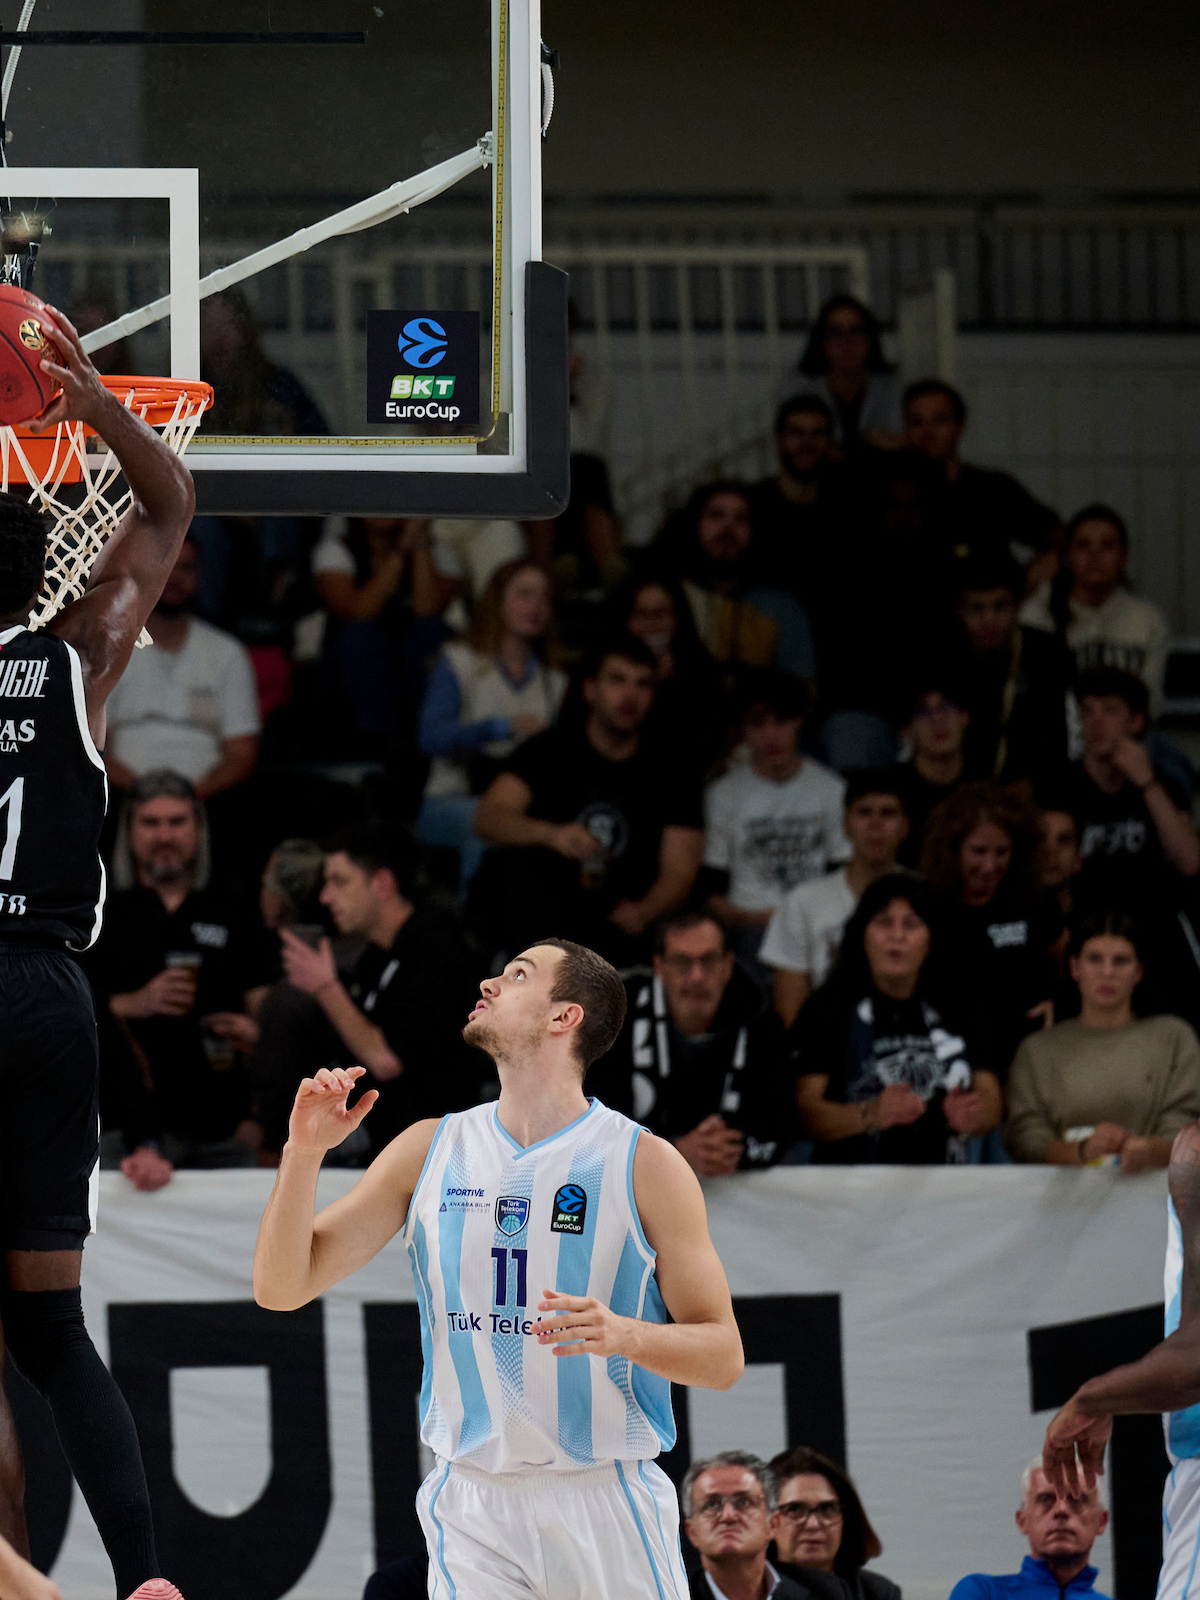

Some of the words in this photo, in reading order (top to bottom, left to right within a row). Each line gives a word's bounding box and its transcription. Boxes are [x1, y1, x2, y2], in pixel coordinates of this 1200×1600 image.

[392, 379, 453, 395] BKT
[385, 402, 461, 422] EuroCup
[446, 1188, 485, 1197] SPORTIVE
[501, 1205, 526, 1213] Telekom
[557, 1214, 579, 1222] BKT
[553, 1222, 582, 1231] EuroCup
[491, 1247, 528, 1308] 11
[489, 1313, 568, 1336] Tele
